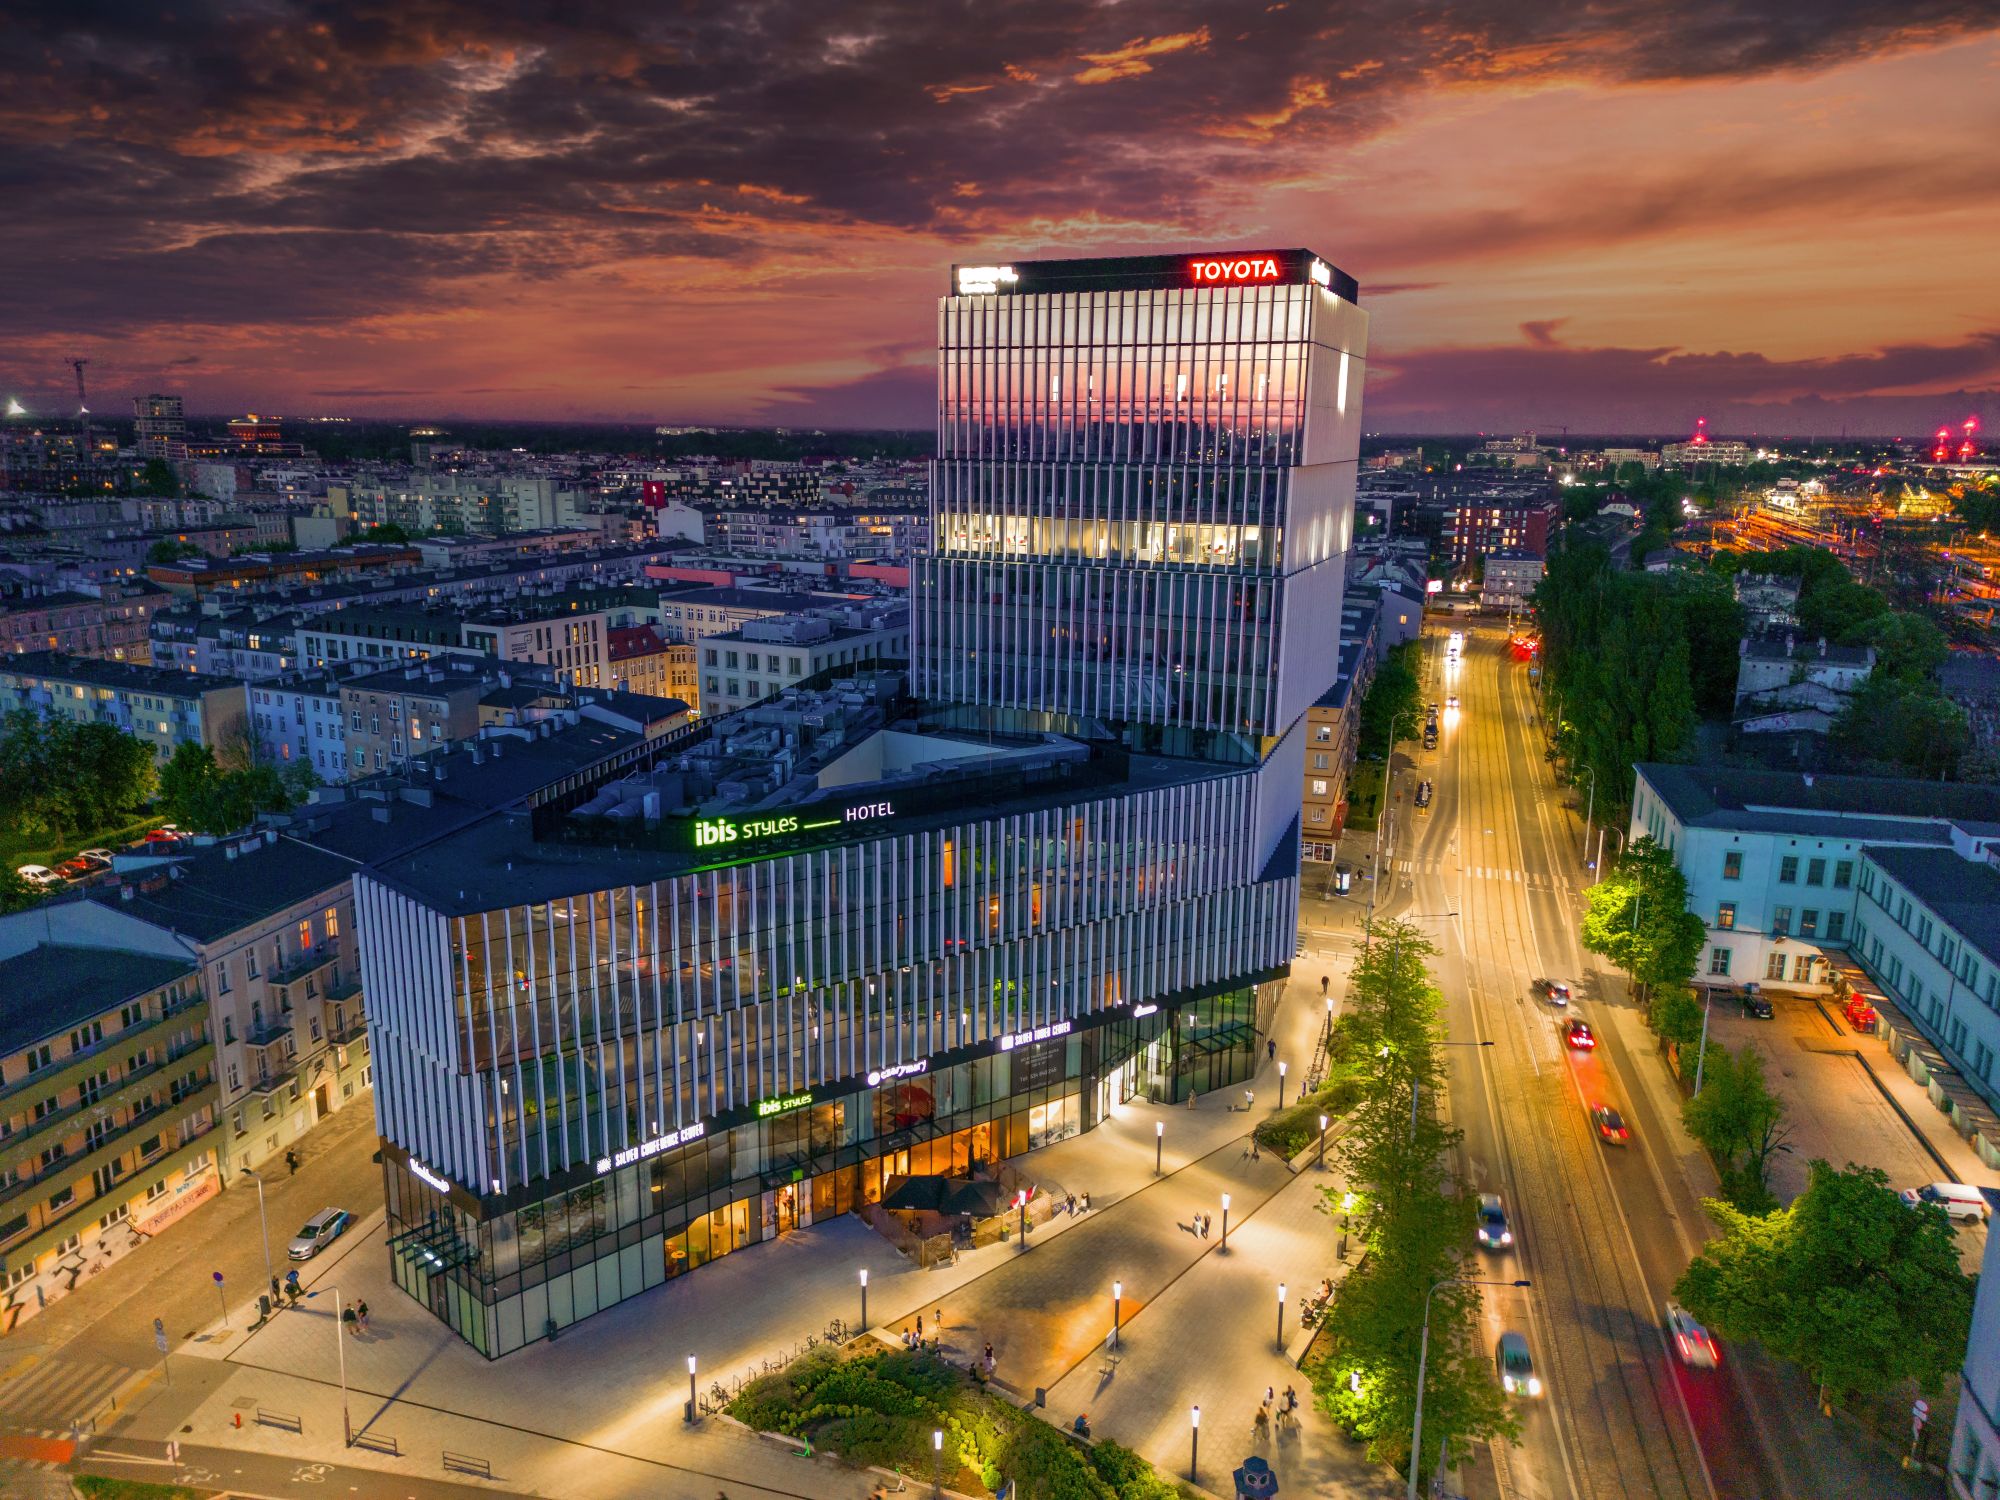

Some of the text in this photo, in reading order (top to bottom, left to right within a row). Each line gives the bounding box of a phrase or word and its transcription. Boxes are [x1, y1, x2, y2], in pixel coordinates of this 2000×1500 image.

[1193, 259, 1278, 280] TOYOTA
[695, 818, 738, 847] ibis
[846, 801, 895, 822] HOTEL
[1015, 1032, 1033, 1046] SILVER
[1034, 1026, 1051, 1041] TOWER
[1052, 1021, 1071, 1036] CENTER
[758, 1100, 782, 1116] ibis
[615, 1122, 704, 1167] SILVER CONFERENCE CENTER
